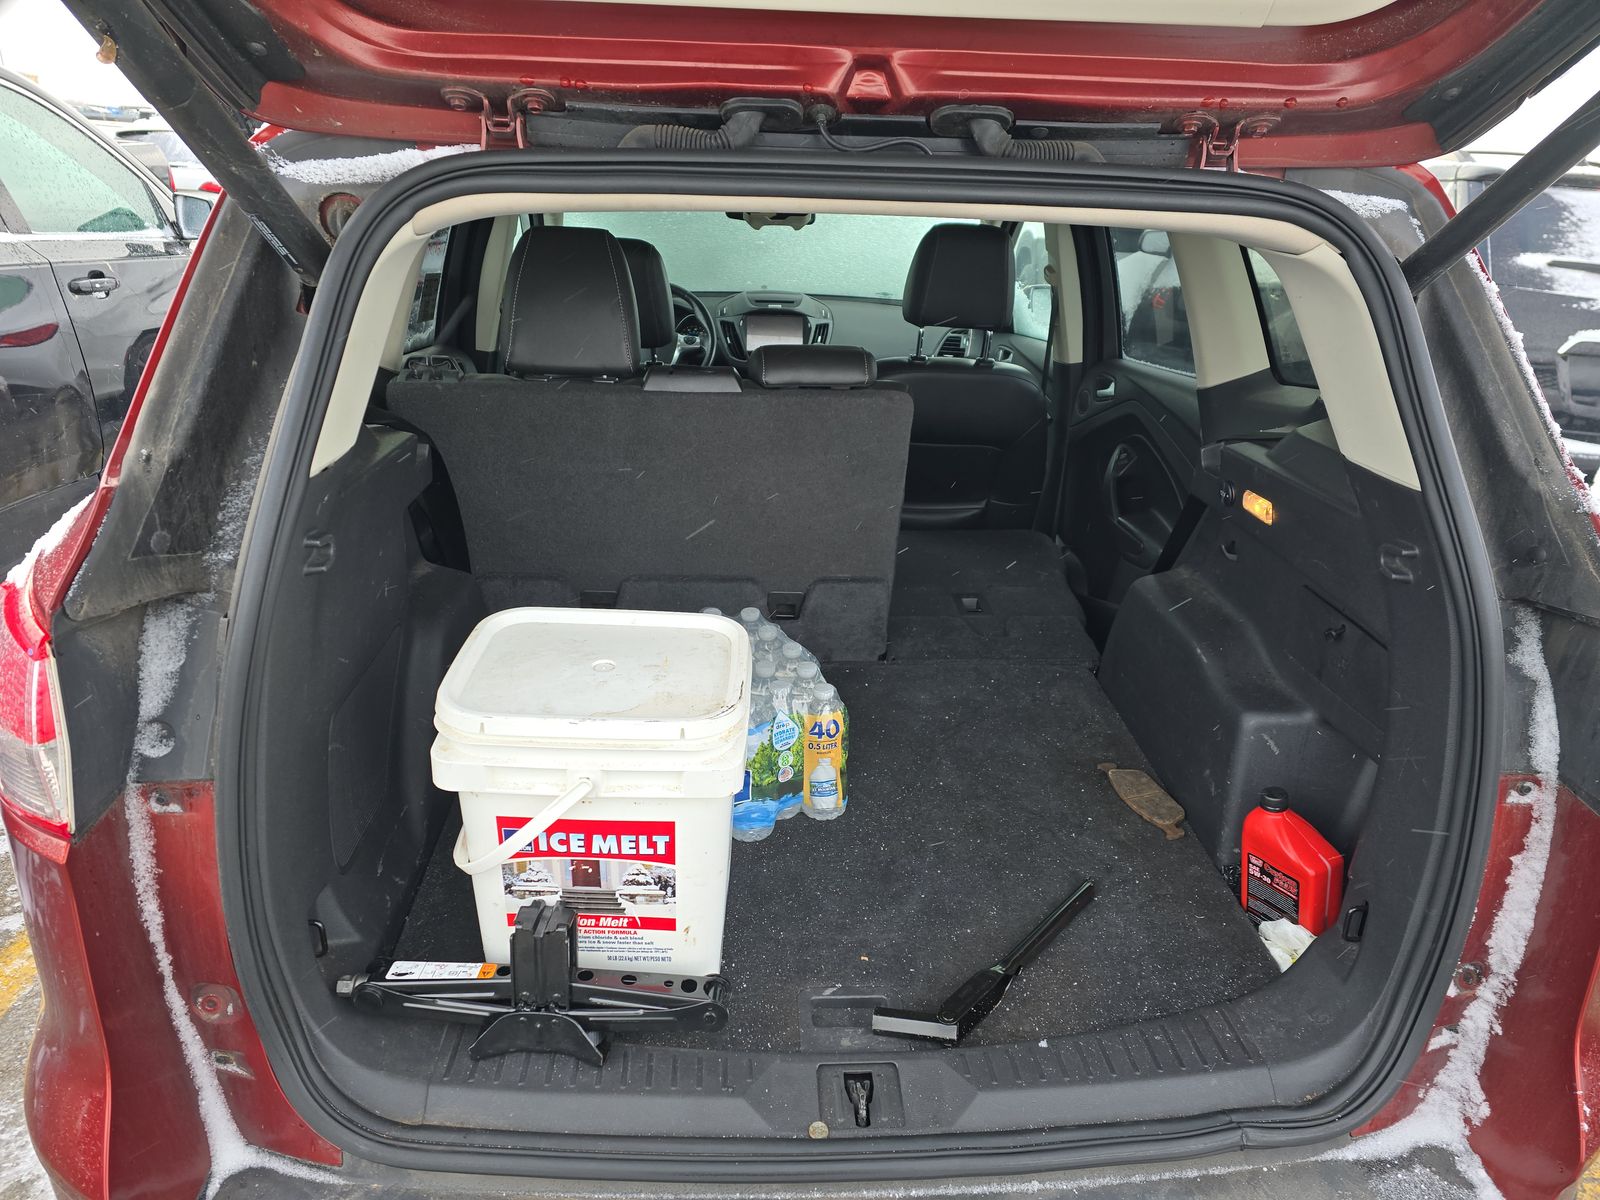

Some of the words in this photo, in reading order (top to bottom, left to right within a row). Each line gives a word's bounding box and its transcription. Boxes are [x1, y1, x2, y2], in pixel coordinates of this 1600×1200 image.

[808, 719, 840, 740] 40
[808, 742, 821, 750] 0.5
[822, 741, 838, 750] LITER
[538, 831, 586, 854] ICE
[591, 834, 670, 856] MELT
